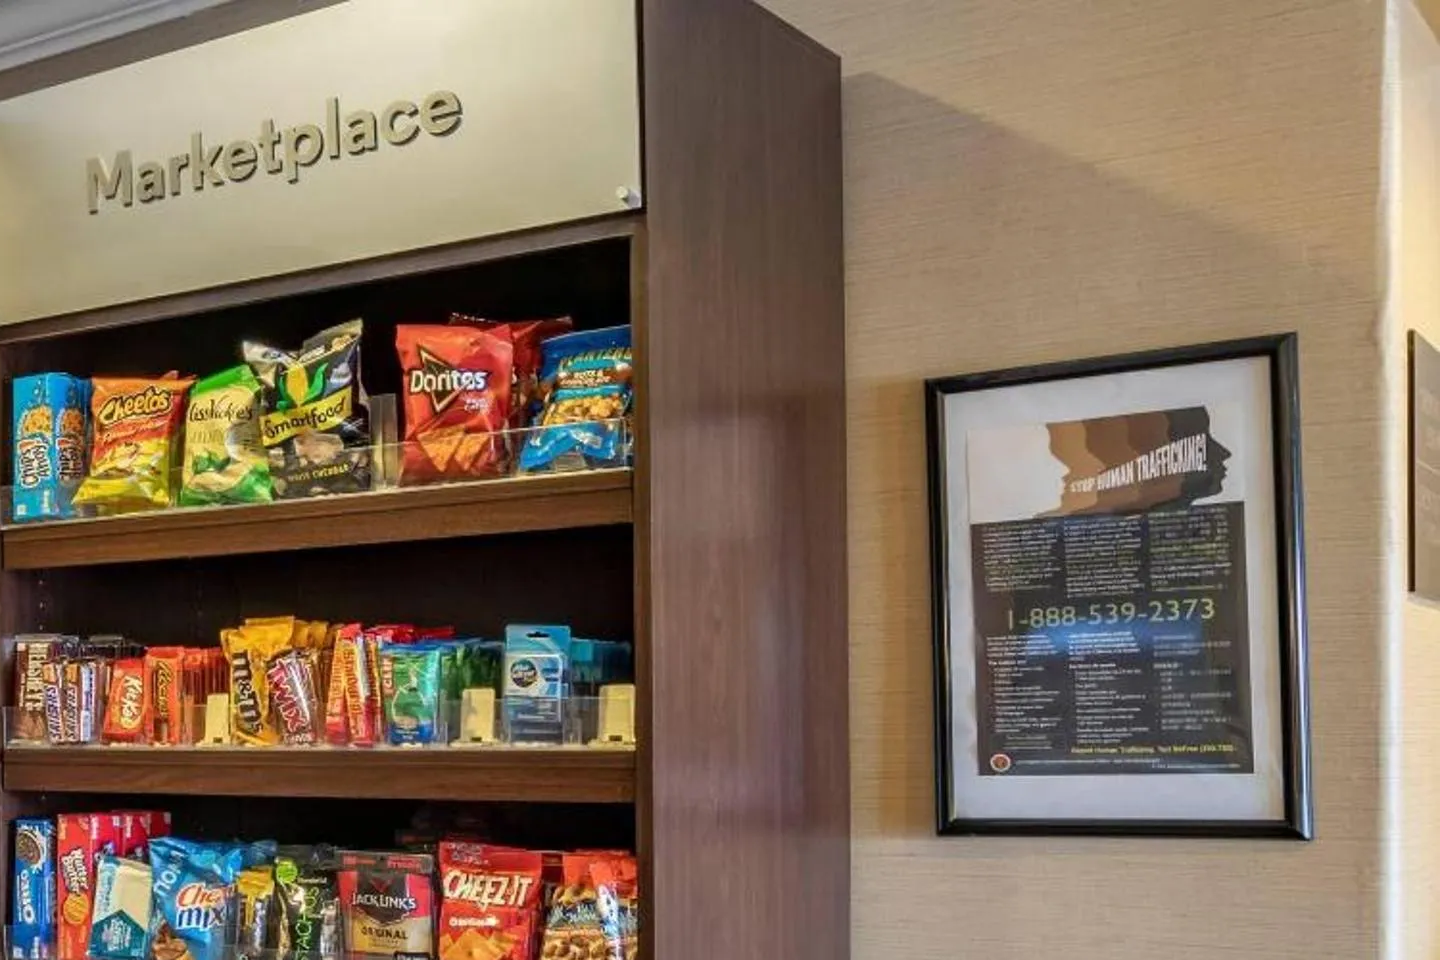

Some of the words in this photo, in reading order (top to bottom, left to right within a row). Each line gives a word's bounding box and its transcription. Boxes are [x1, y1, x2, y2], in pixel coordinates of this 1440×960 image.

[85, 90, 462, 214] Marketplace
[410, 367, 488, 393] Doritos
[99, 387, 172, 424] Cheetos
[263, 397, 346, 438] Smartfood
[1097, 460, 1135, 490] HUMAN
[1137, 433, 1208, 482] TRAFFICKING!
[1008, 598, 1216, 631] 1-888-539-2373
[267, 658, 308, 733] TWIX
[62, 855, 80, 896] Butter
[72, 848, 89, 890] Nutter
[20, 869, 36, 925] OREO
